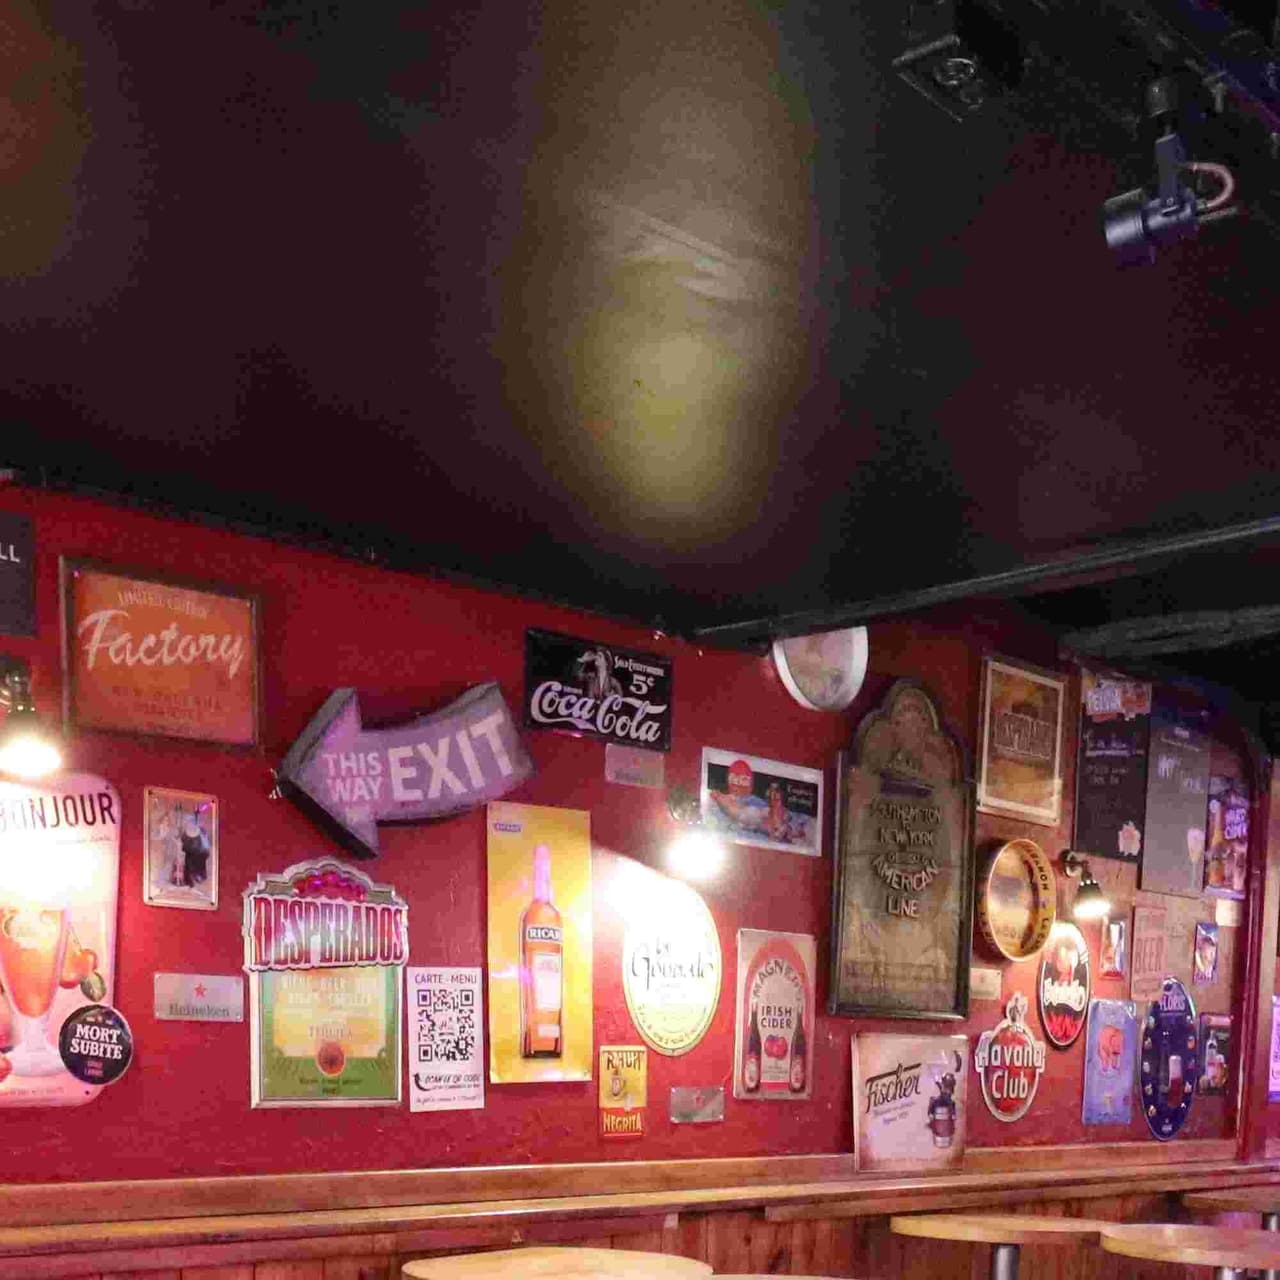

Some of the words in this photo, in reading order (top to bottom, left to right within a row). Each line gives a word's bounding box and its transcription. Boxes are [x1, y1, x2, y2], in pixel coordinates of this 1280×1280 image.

[77, 608, 245, 681] Factory
[323, 752, 383, 777] THIS
[387, 708, 514, 803] EXIT
[326, 775, 385, 801] WAY
[253, 897, 405, 968] DESPERADOS
[414, 973, 442, 984] CARTE
[450, 974, 477, 984] MENU
[760, 1017, 793, 1030] CIDER
[761, 1005, 793, 1018] IRISH
[75, 1023, 121, 1043] MORT
[70, 1038, 123, 1060] SUBITE
[607, 1051, 641, 1071] RHUM
[977, 1043, 1043, 1068] Havana
[864, 1063, 922, 1114] Fischer
[991, 1069, 1029, 1099] Club
[603, 1112, 643, 1133] NEGRITA
